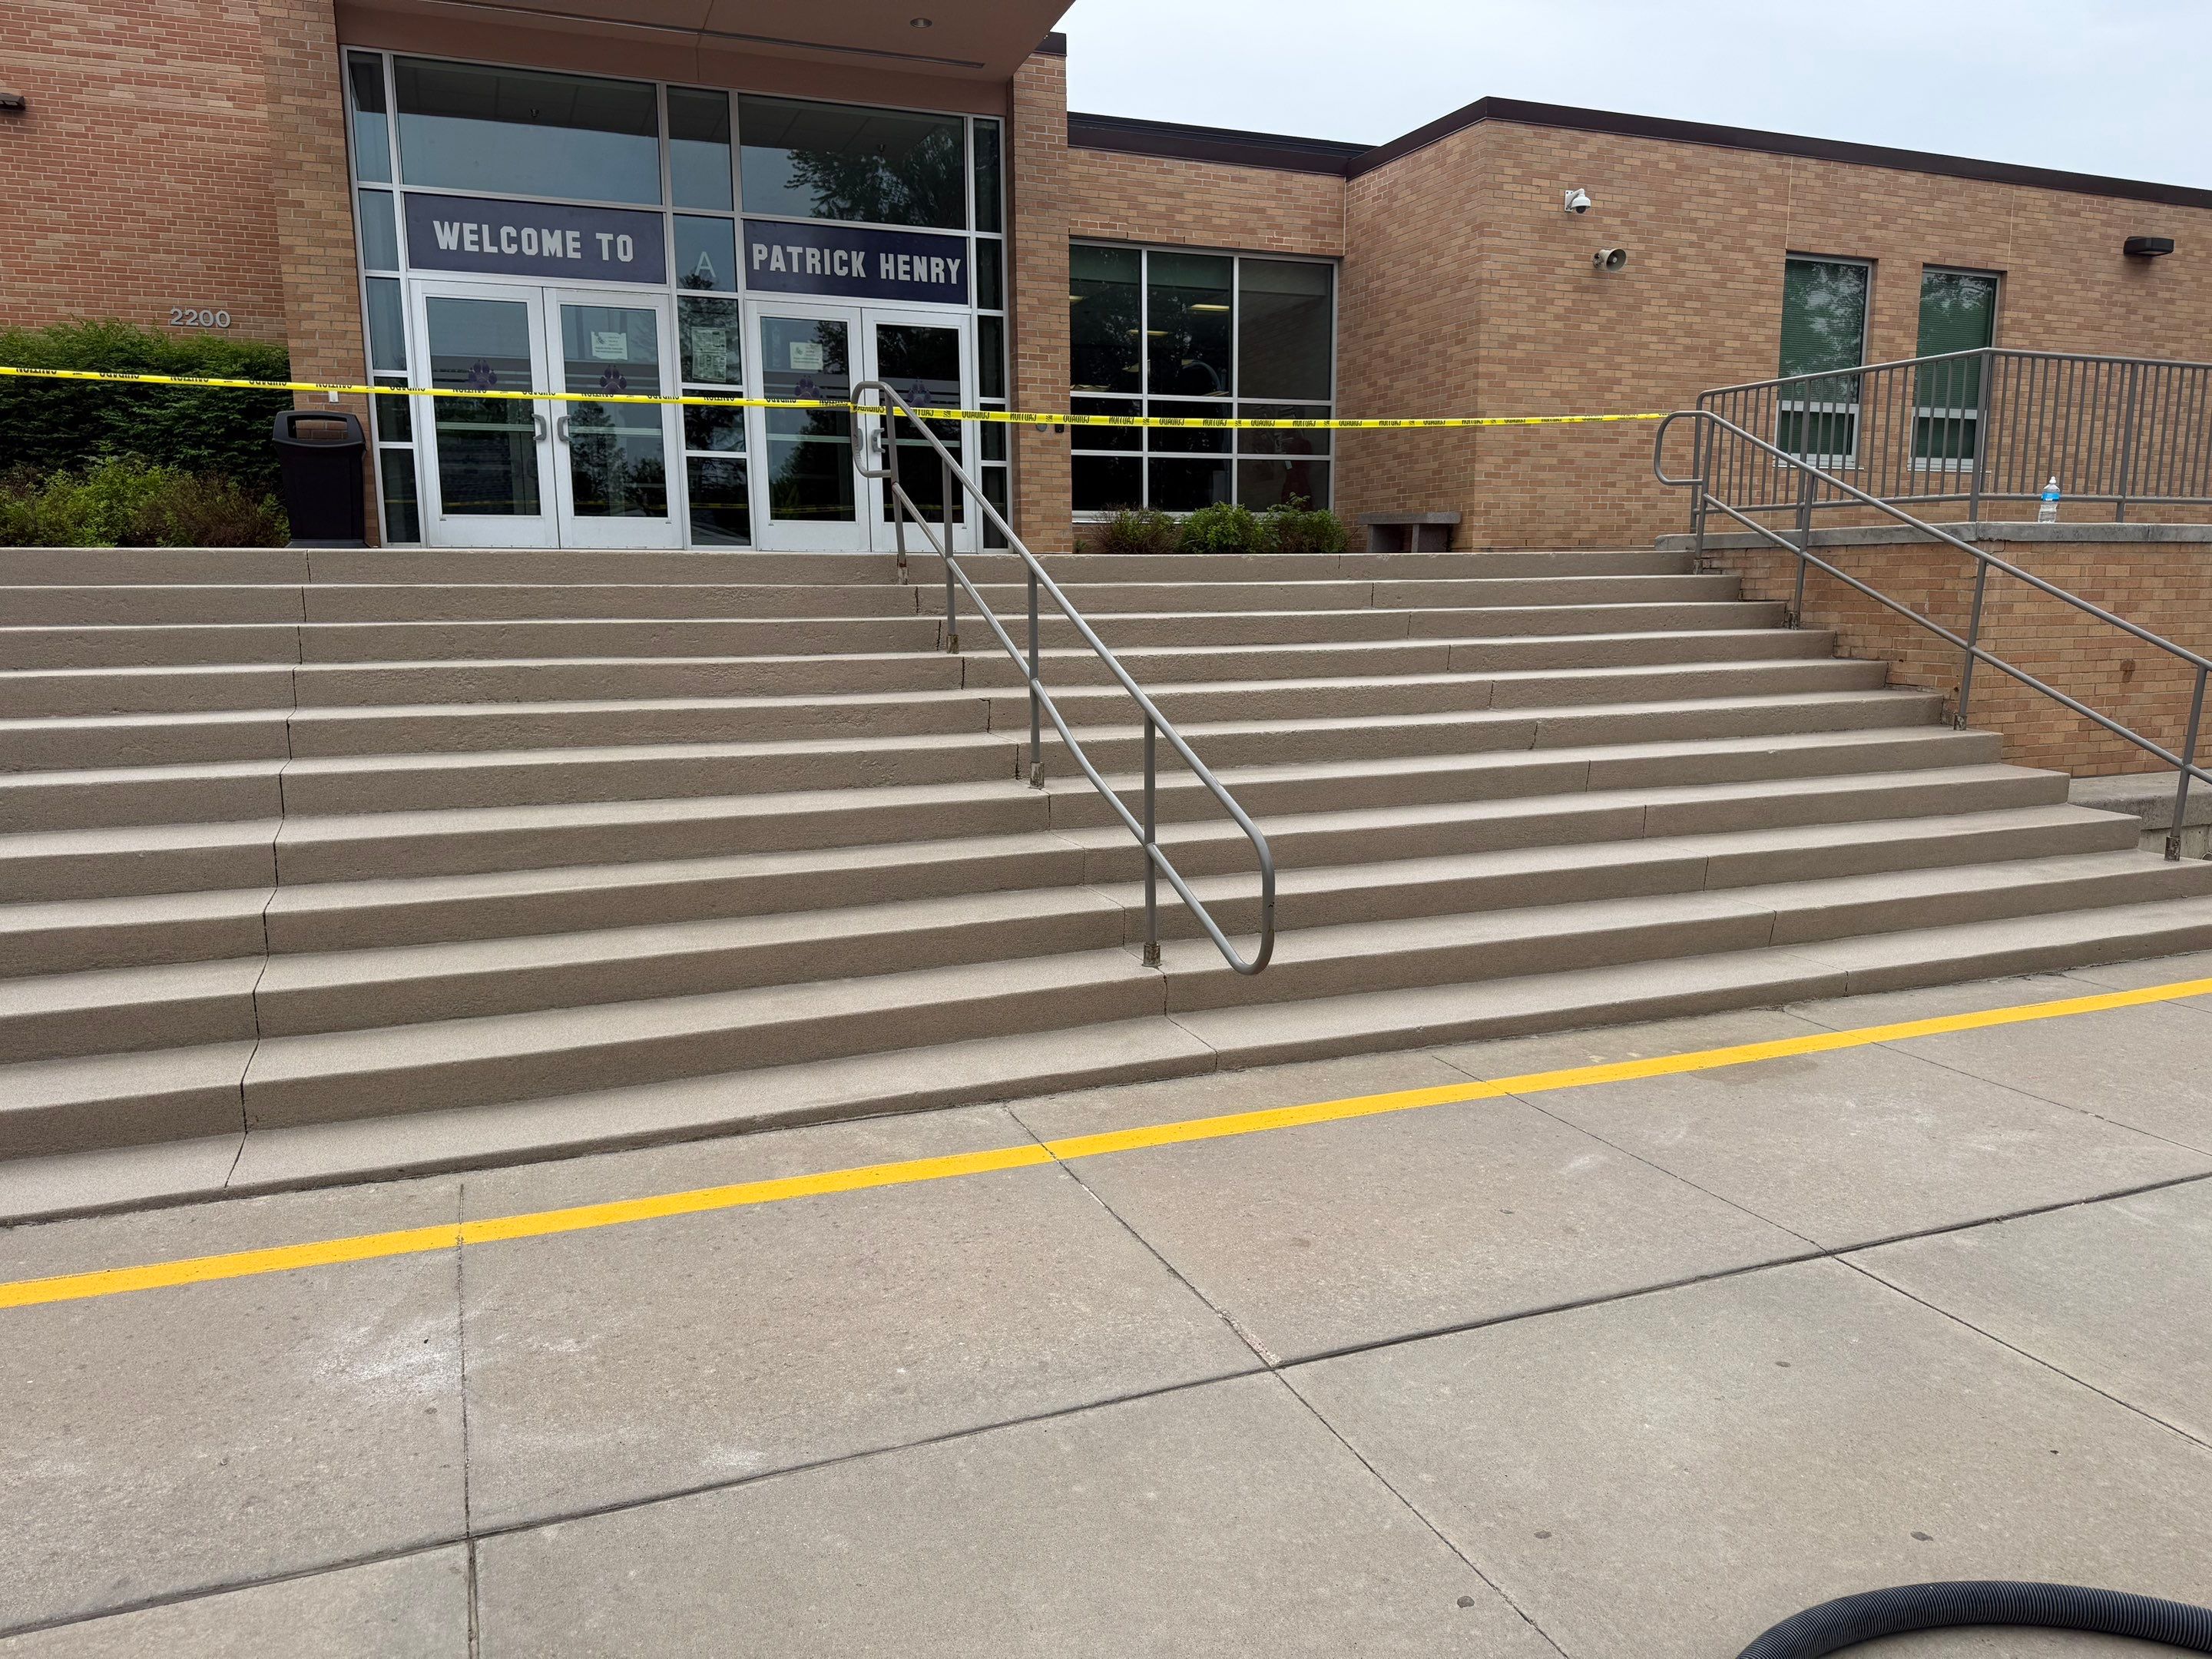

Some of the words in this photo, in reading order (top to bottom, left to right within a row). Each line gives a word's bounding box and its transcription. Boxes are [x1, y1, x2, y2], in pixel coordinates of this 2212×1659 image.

[432, 220, 581, 259] WELCOME
[595, 233, 634, 263] TO
[694, 251, 716, 277] A
[753, 243, 866, 278] PATRICK
[879, 253, 961, 284] HENRY
[170, 308, 230, 328] 2200
